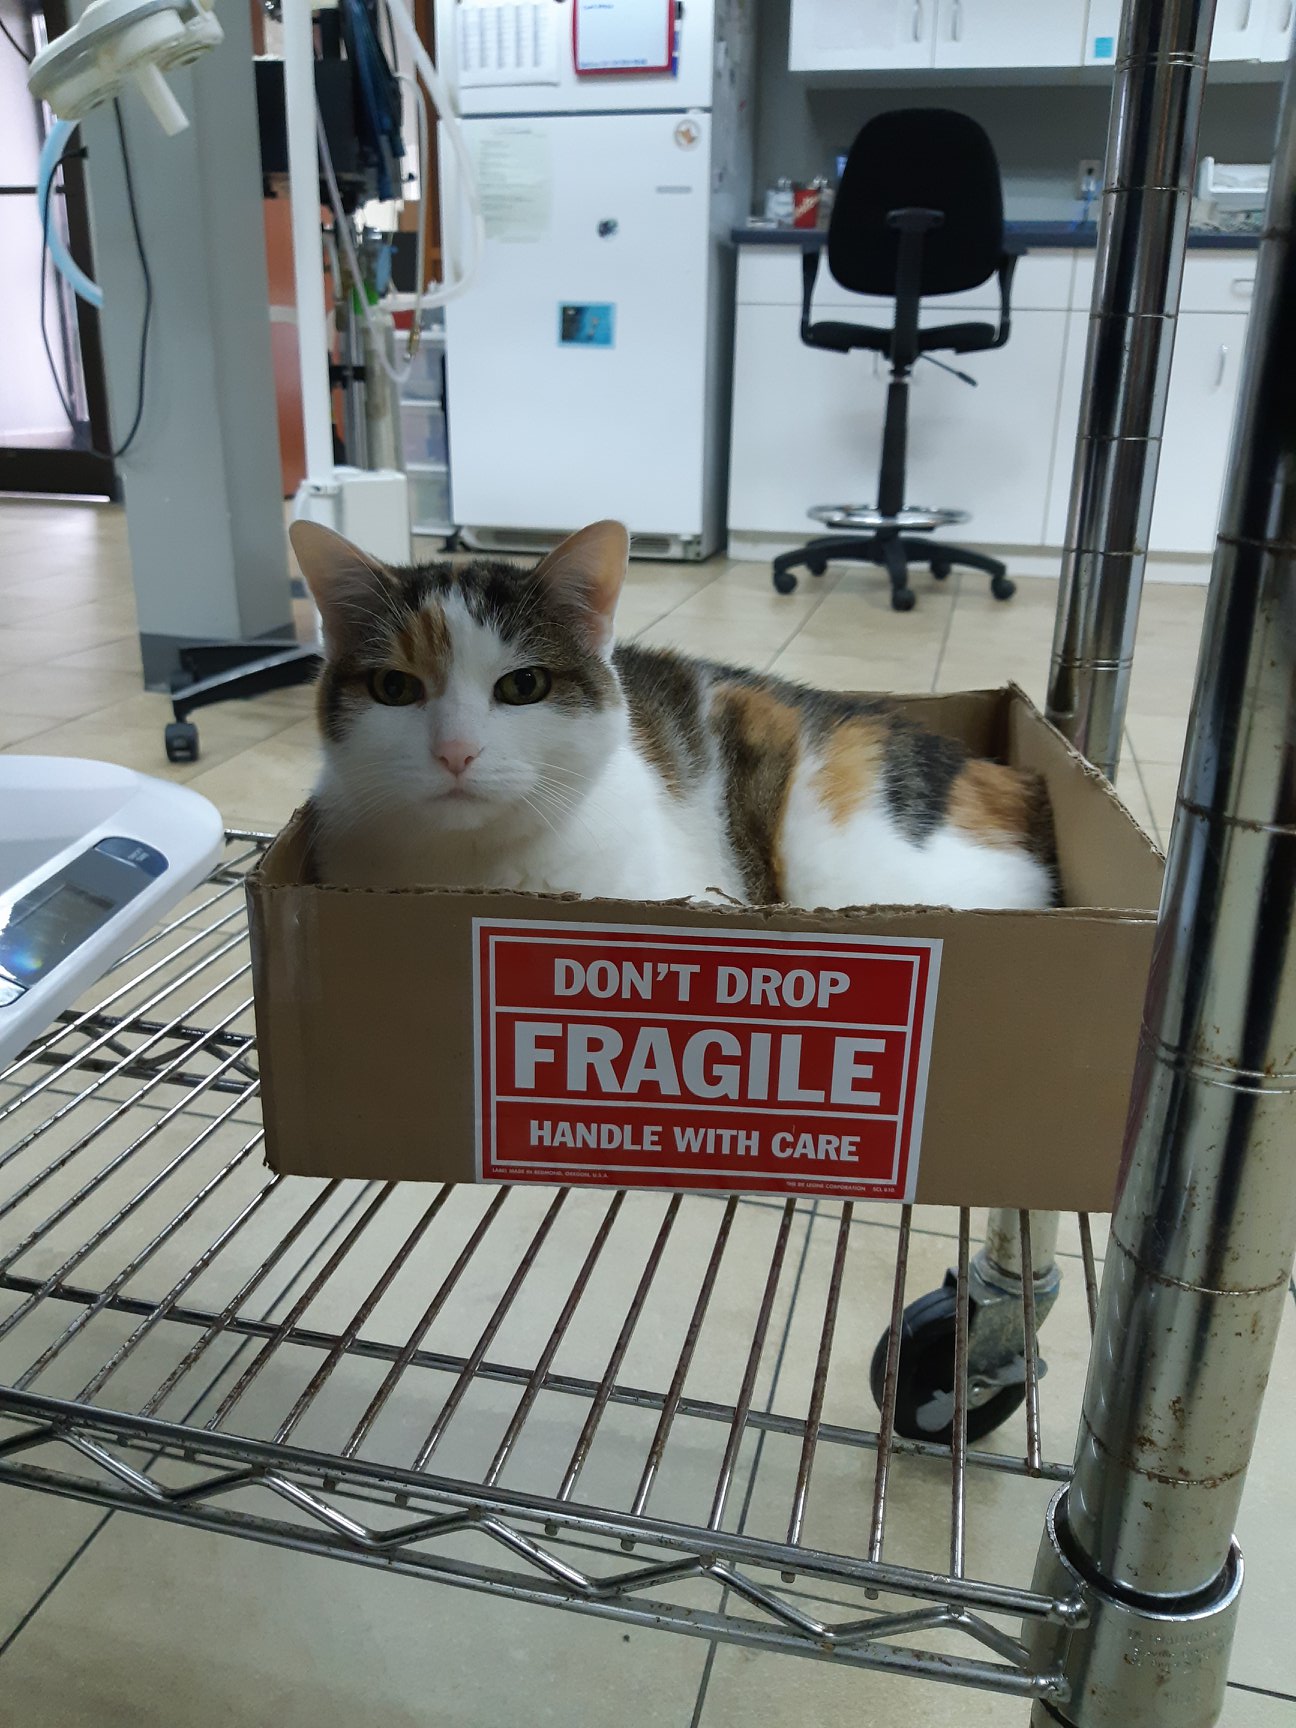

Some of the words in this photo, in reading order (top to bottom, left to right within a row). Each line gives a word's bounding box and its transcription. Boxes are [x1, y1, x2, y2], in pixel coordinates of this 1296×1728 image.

[554, 958, 701, 1001] DON'T
[716, 964, 851, 1008] DROP
[514, 1021, 886, 1107] FRAGILE
[530, 1120, 663, 1151] HANDLE
[673, 1126, 760, 1156] WITH
[771, 1130, 861, 1162] CARE
[825, 1183, 866, 1191] CORPORATION
